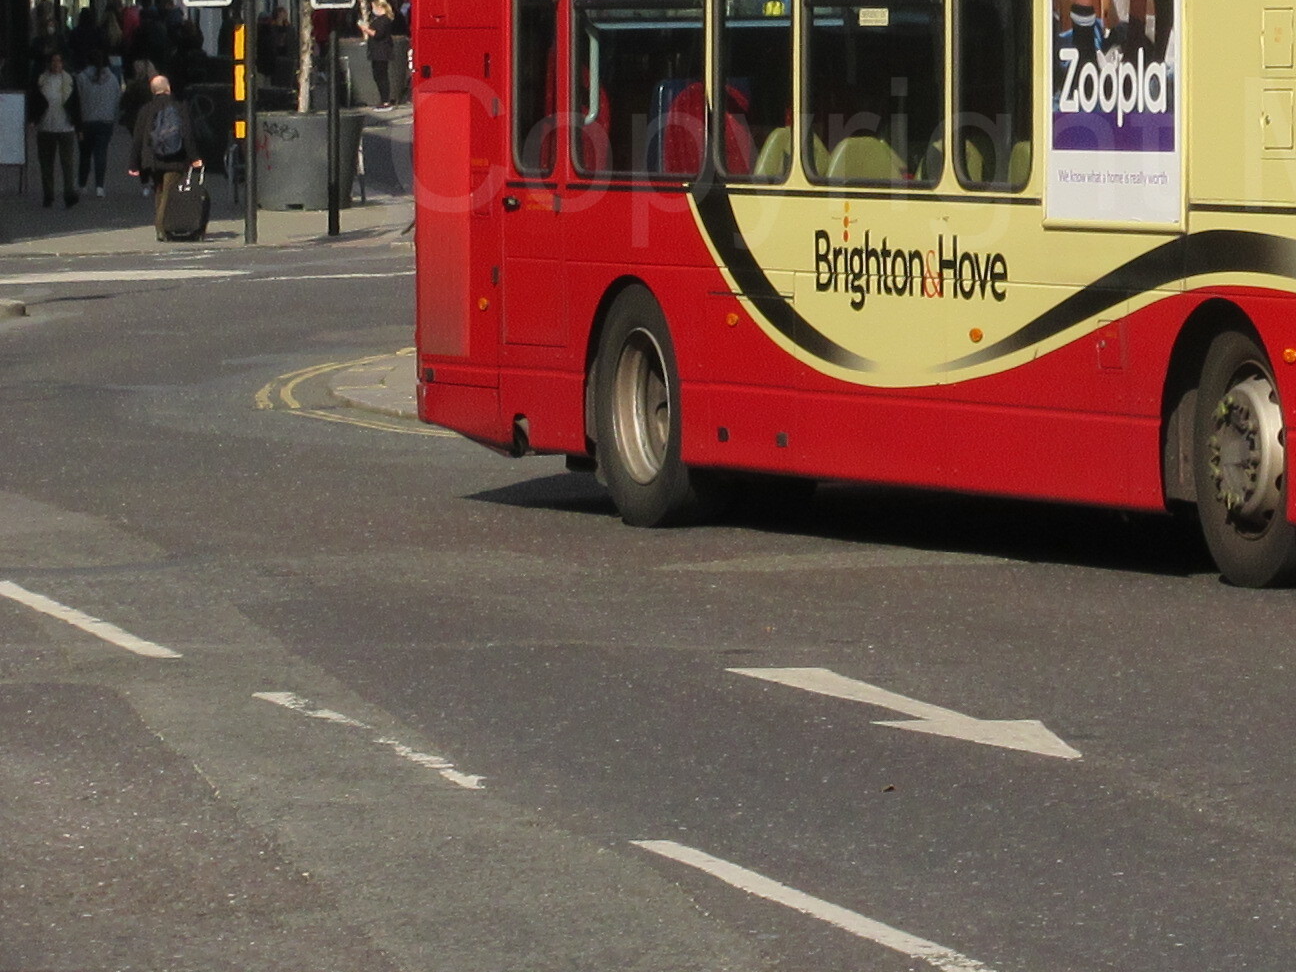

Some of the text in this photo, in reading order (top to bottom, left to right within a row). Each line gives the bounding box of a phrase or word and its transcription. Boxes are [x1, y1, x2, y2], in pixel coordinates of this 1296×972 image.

[1059, 46, 1167, 128] Zoopla
[1058, 169, 1069, 183] We
[1070, 169, 1086, 183] know
[1087, 169, 1101, 183] what
[1107, 170, 1124, 184] home
[1129, 170, 1147, 187] really
[1148, 171, 1168, 185] worth
[814, 227, 1009, 312] Brighton&Hove
